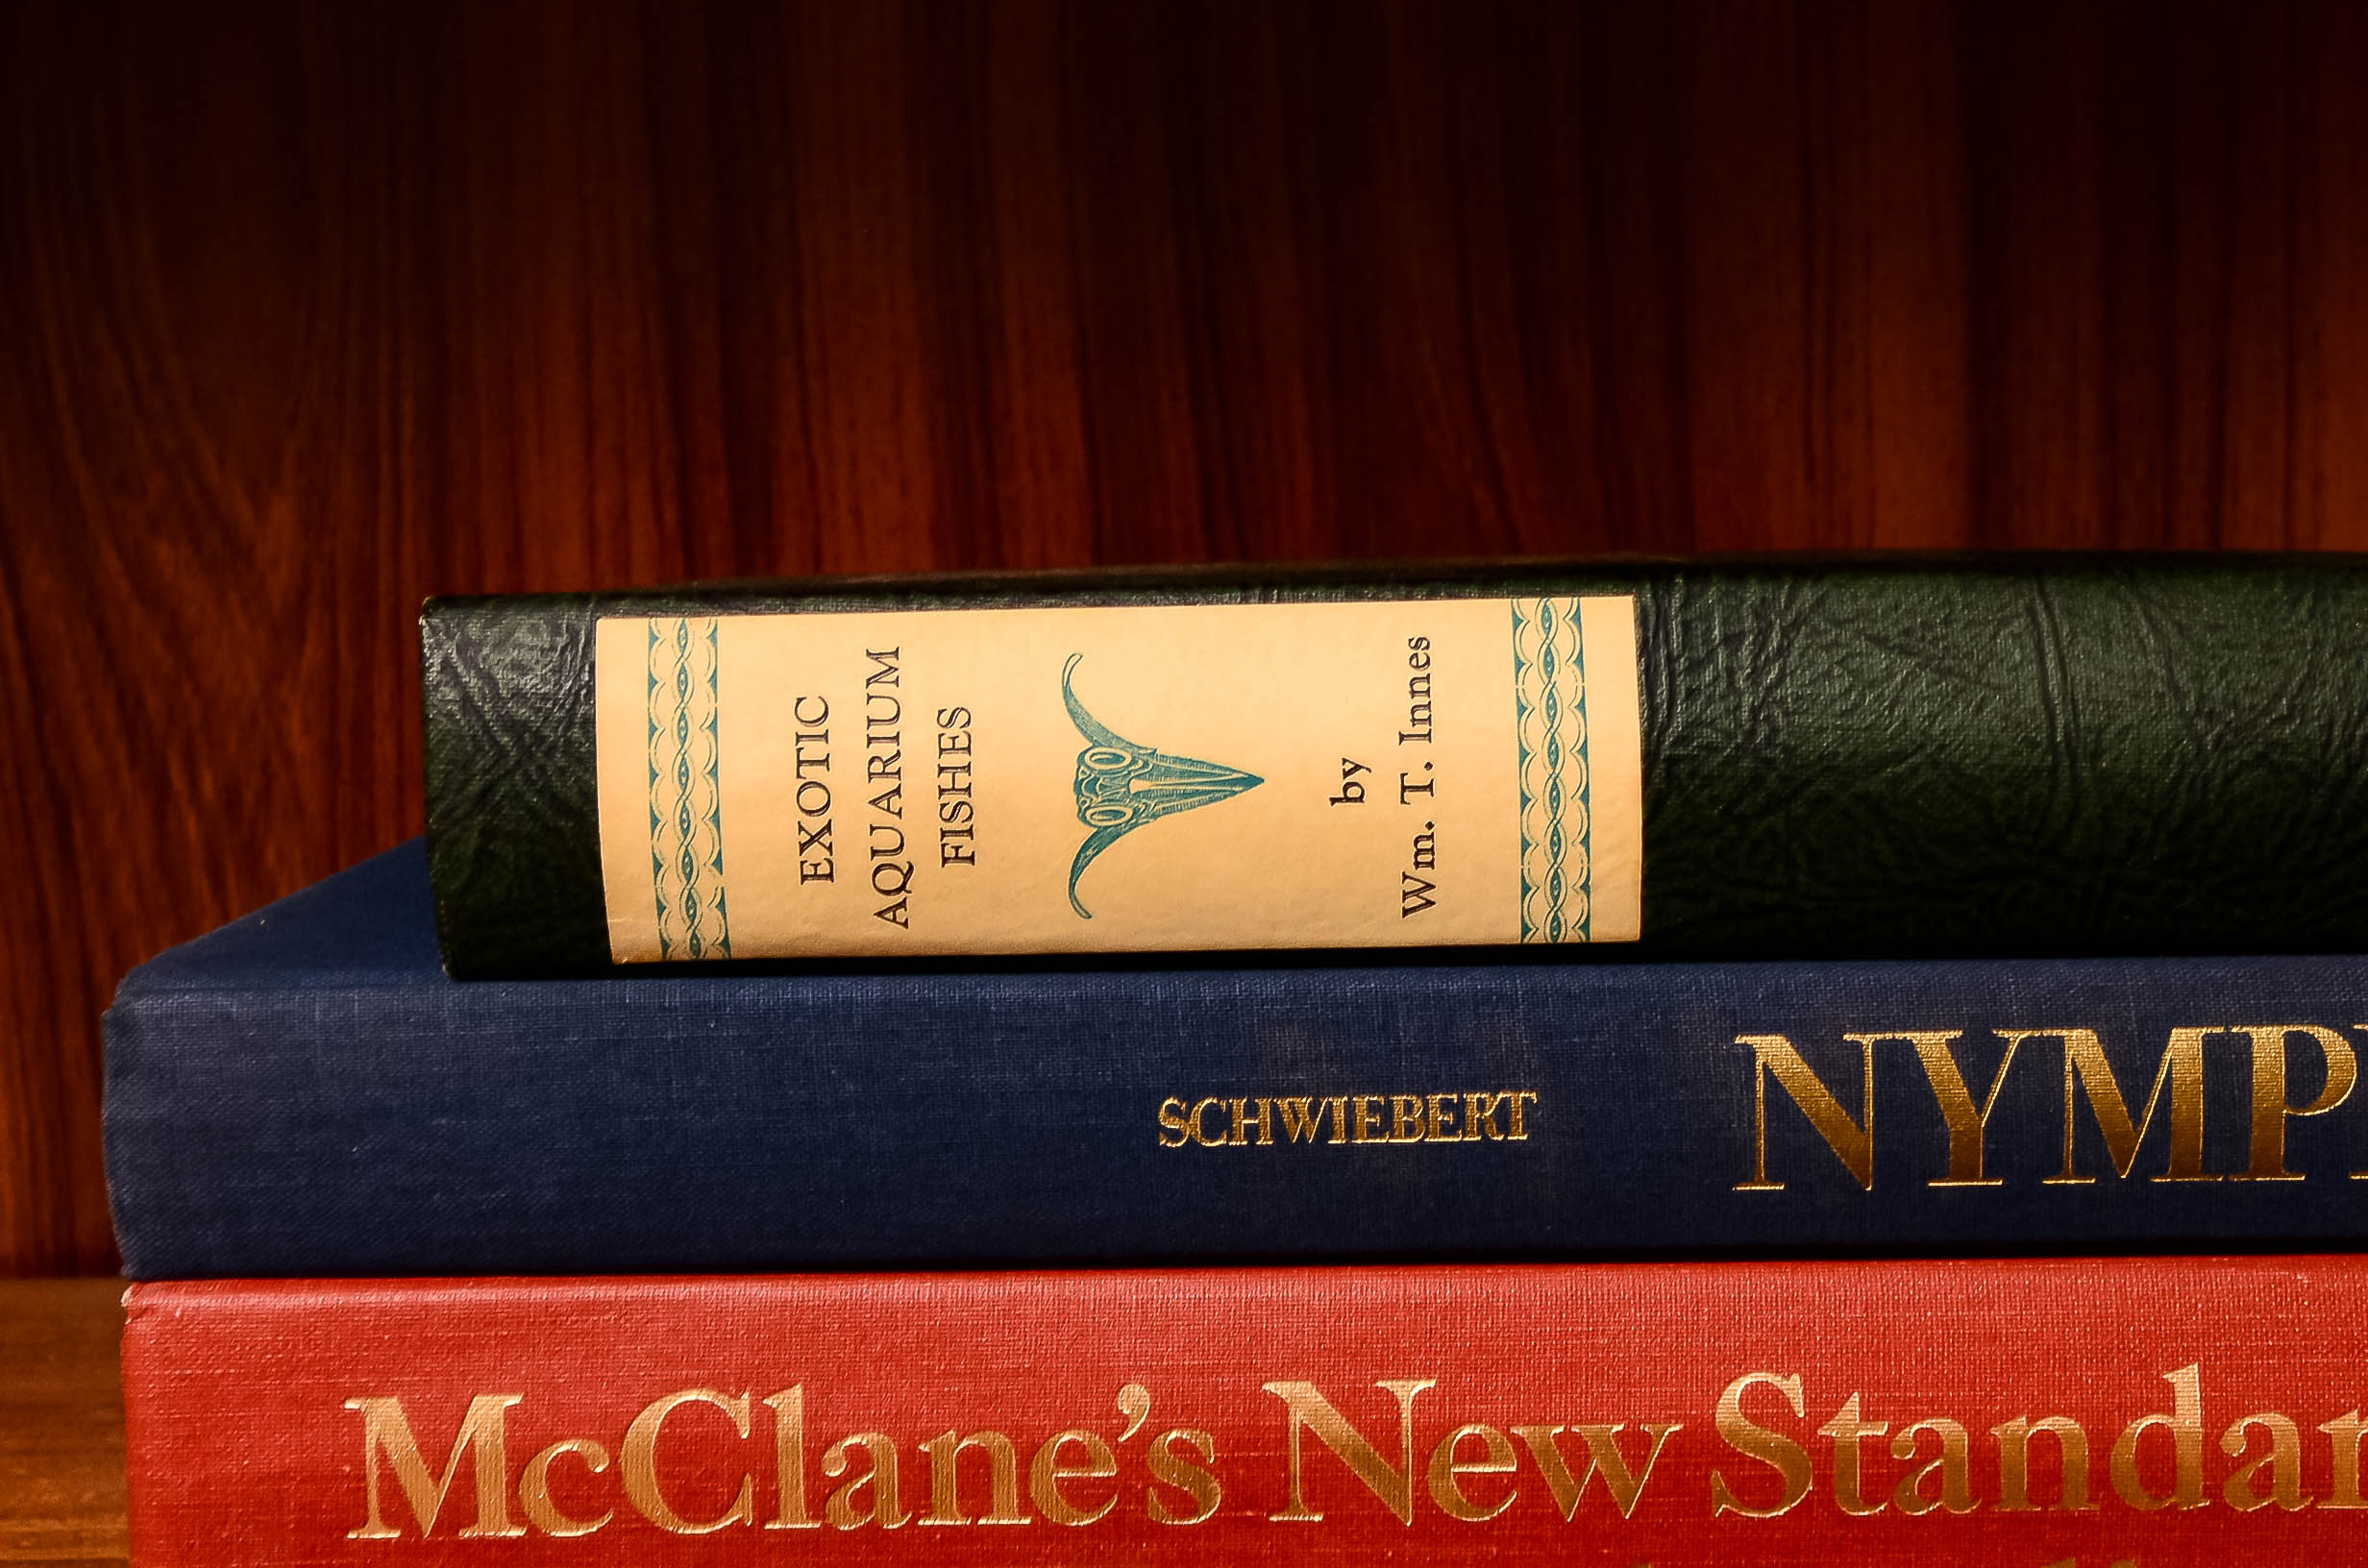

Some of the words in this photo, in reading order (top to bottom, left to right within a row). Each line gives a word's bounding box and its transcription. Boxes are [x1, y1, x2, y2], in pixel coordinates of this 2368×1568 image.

[1398, 635, 1432, 746] Innes
[794, 696, 835, 885] EXOTIC
[865, 646, 915, 929] AQUARIUM
[936, 706, 975, 868] FISHES
[1328, 757, 1372, 806] by
[1399, 762, 1435, 805] T.
[1401, 821, 1437, 919] Wm.
[1157, 1090, 1538, 1147] SCHWIEBERT
[1733, 1024, 2368, 1190] NYMP
[344, 1383, 1222, 1539] McClane's
[1261, 1378, 1683, 1527] New
